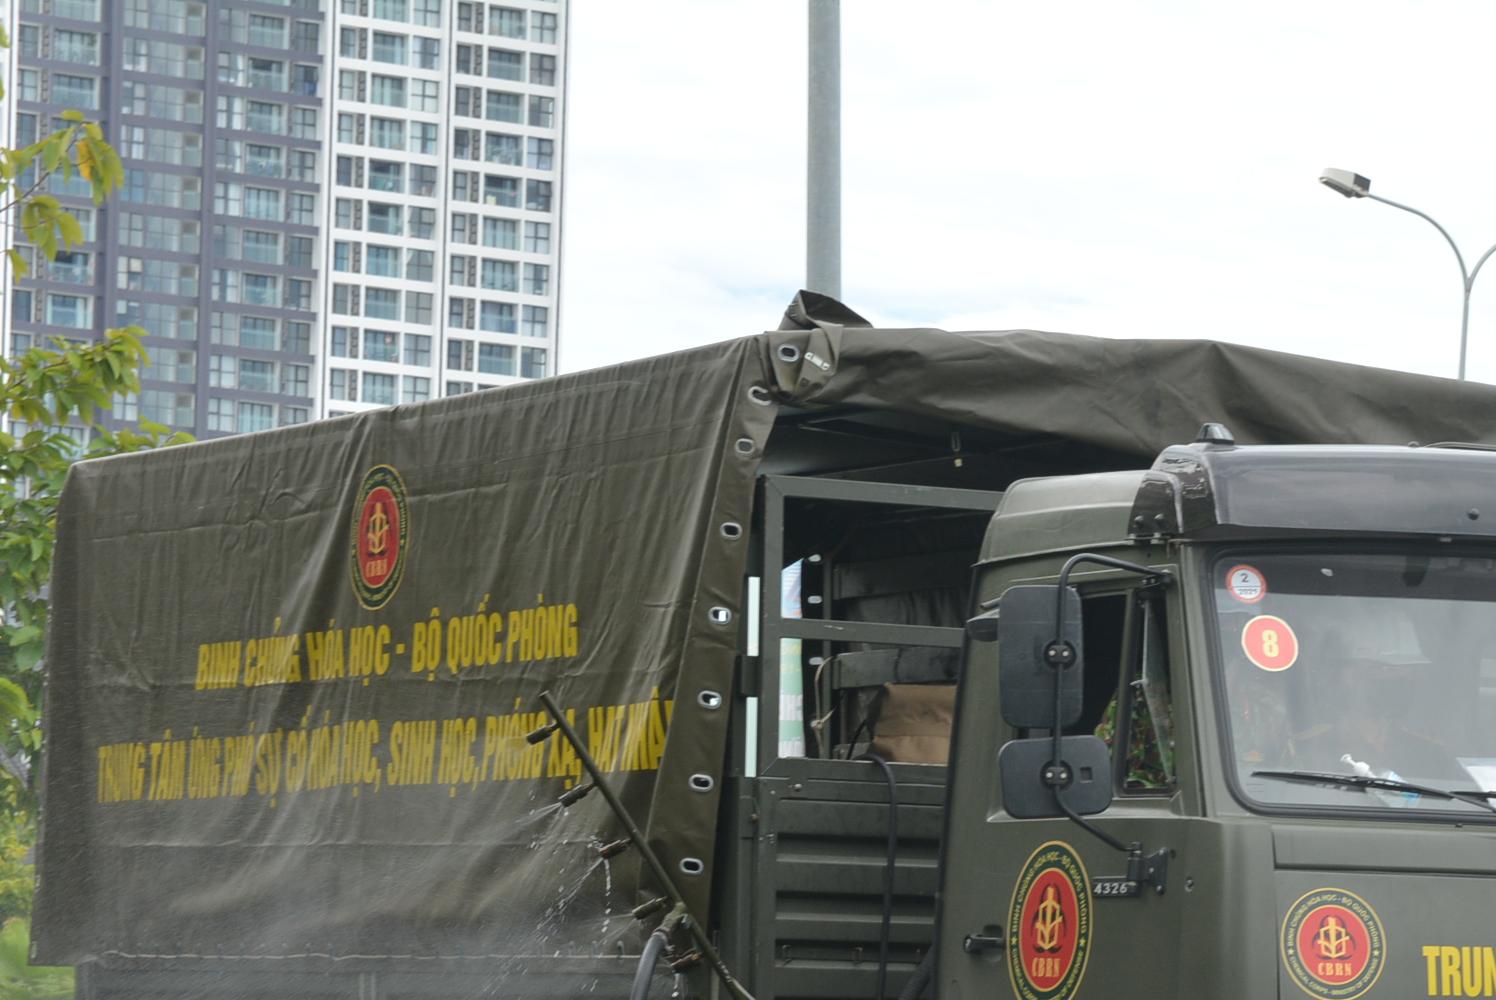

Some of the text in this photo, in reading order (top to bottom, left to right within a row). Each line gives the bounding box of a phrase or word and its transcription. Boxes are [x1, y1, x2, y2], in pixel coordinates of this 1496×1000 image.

[1240, 573, 1249, 583] 2
[195, 640, 242, 690] BINH
[305, 618, 344, 681] HÓA
[350, 624, 391, 686] HỌC
[395, 643, 406, 654] -
[411, 606, 442, 681] BỘ
[447, 592, 503, 674] QUỐC
[505, 592, 578, 663] PHÒNG
[1262, 629, 1279, 658] 8
[149, 728, 186, 801] TÂM
[255, 727, 284, 808] SỰ
[387, 719, 437, 785] SINH
[1093, 881, 1128, 894] 4326
[1317, 962, 1352, 977] CBRN
